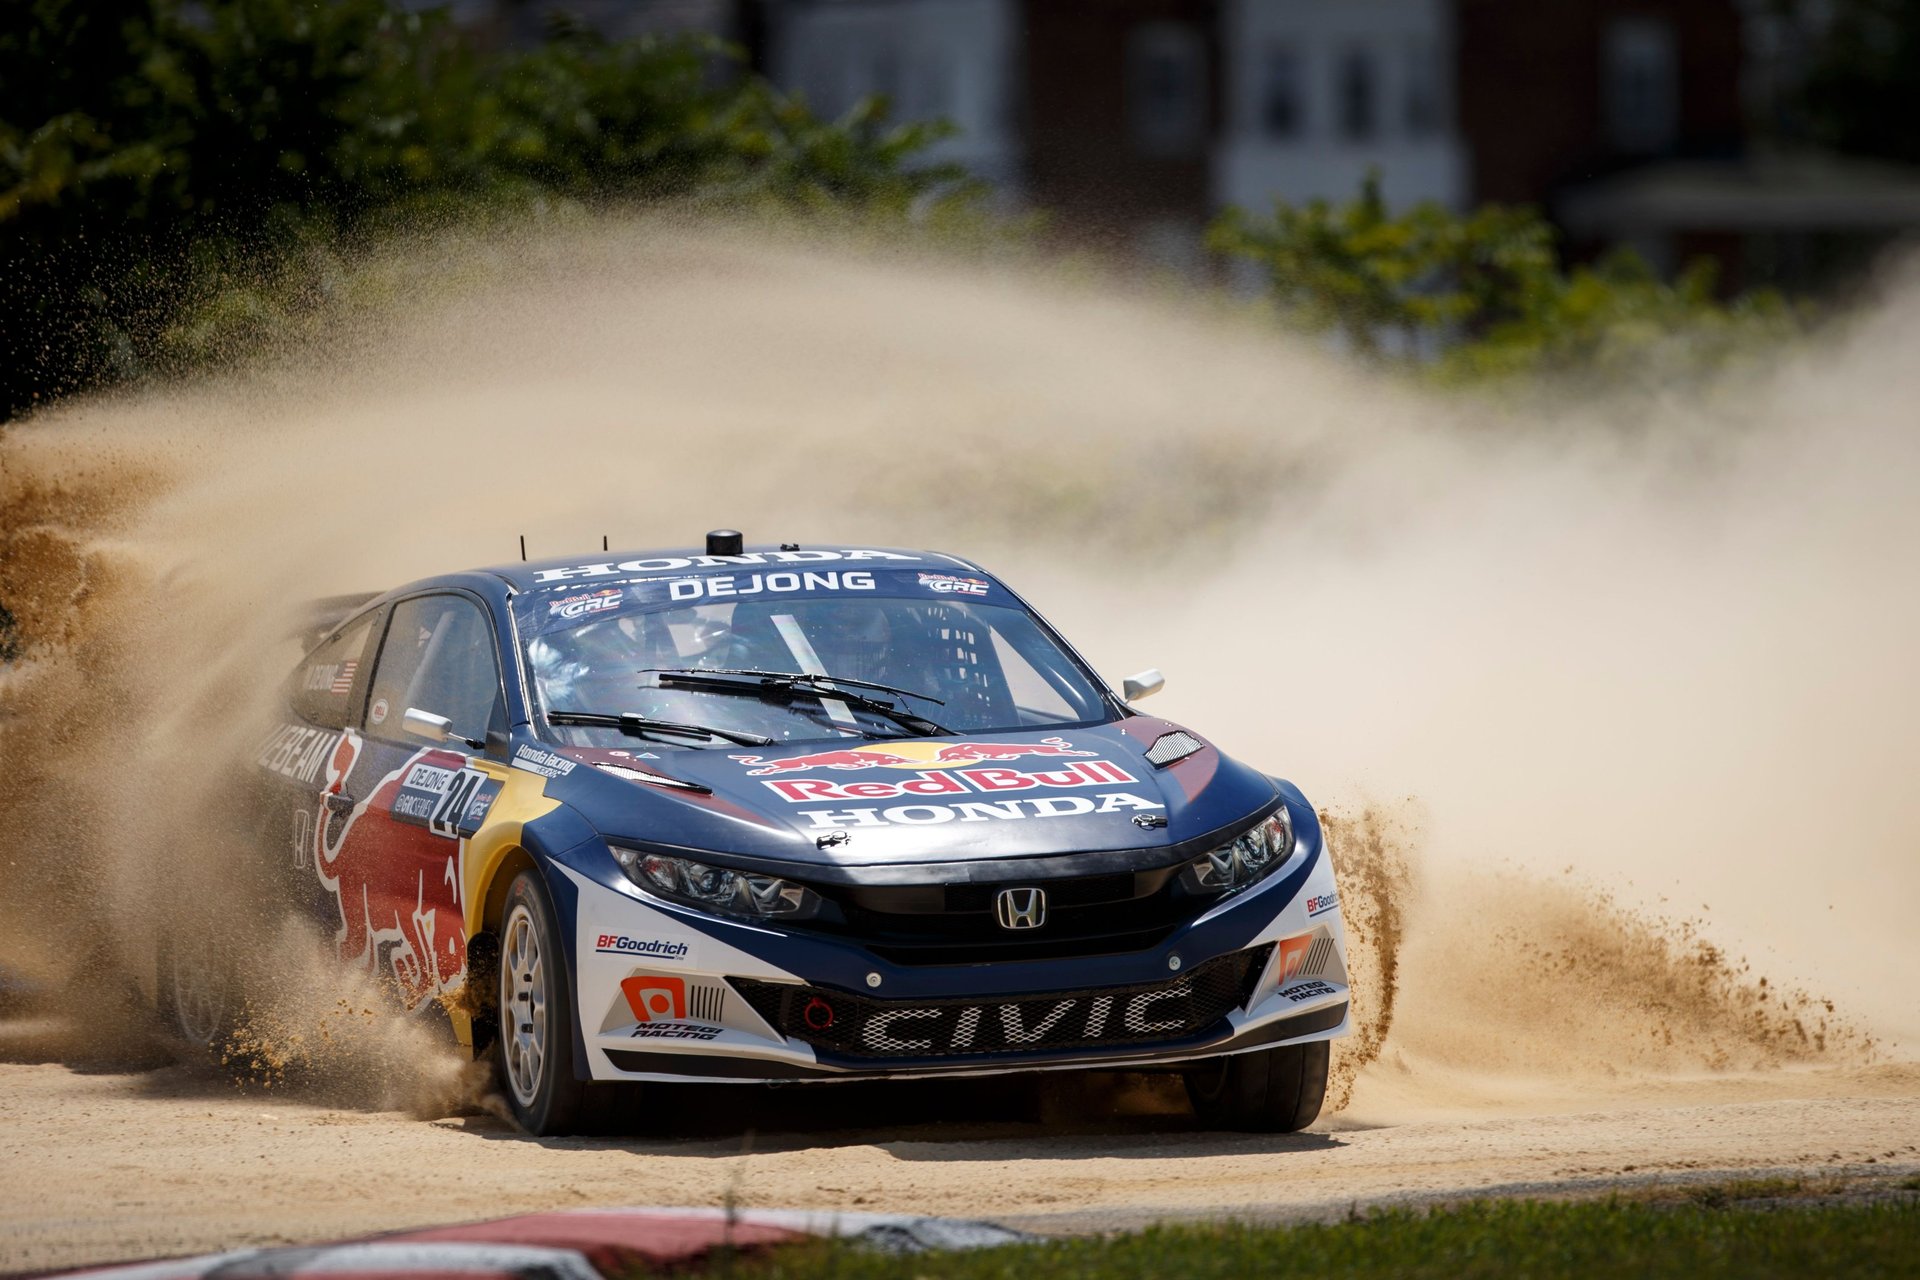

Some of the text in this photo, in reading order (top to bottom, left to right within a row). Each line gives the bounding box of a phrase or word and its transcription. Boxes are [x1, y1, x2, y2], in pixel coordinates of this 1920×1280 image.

[533, 549, 921, 583] HONDA
[670, 571, 876, 601] DEJONG
[563, 594, 623, 617] GRC
[515, 743, 549, 764] Honda
[410, 768, 449, 791] DEJONG
[761, 759, 1140, 803] Red Bull
[432, 771, 481, 835] 24
[797, 792, 1167, 829] HONDA
[596, 934, 689, 956] BFGoodrich
[1278, 981, 1328, 998] MOTEGI
[1288, 987, 1337, 1002] RACING
[634, 1022, 725, 1034] MOTEGI
[861, 986, 1193, 1051] CIVIC
[630, 1030, 718, 1041] RACING
